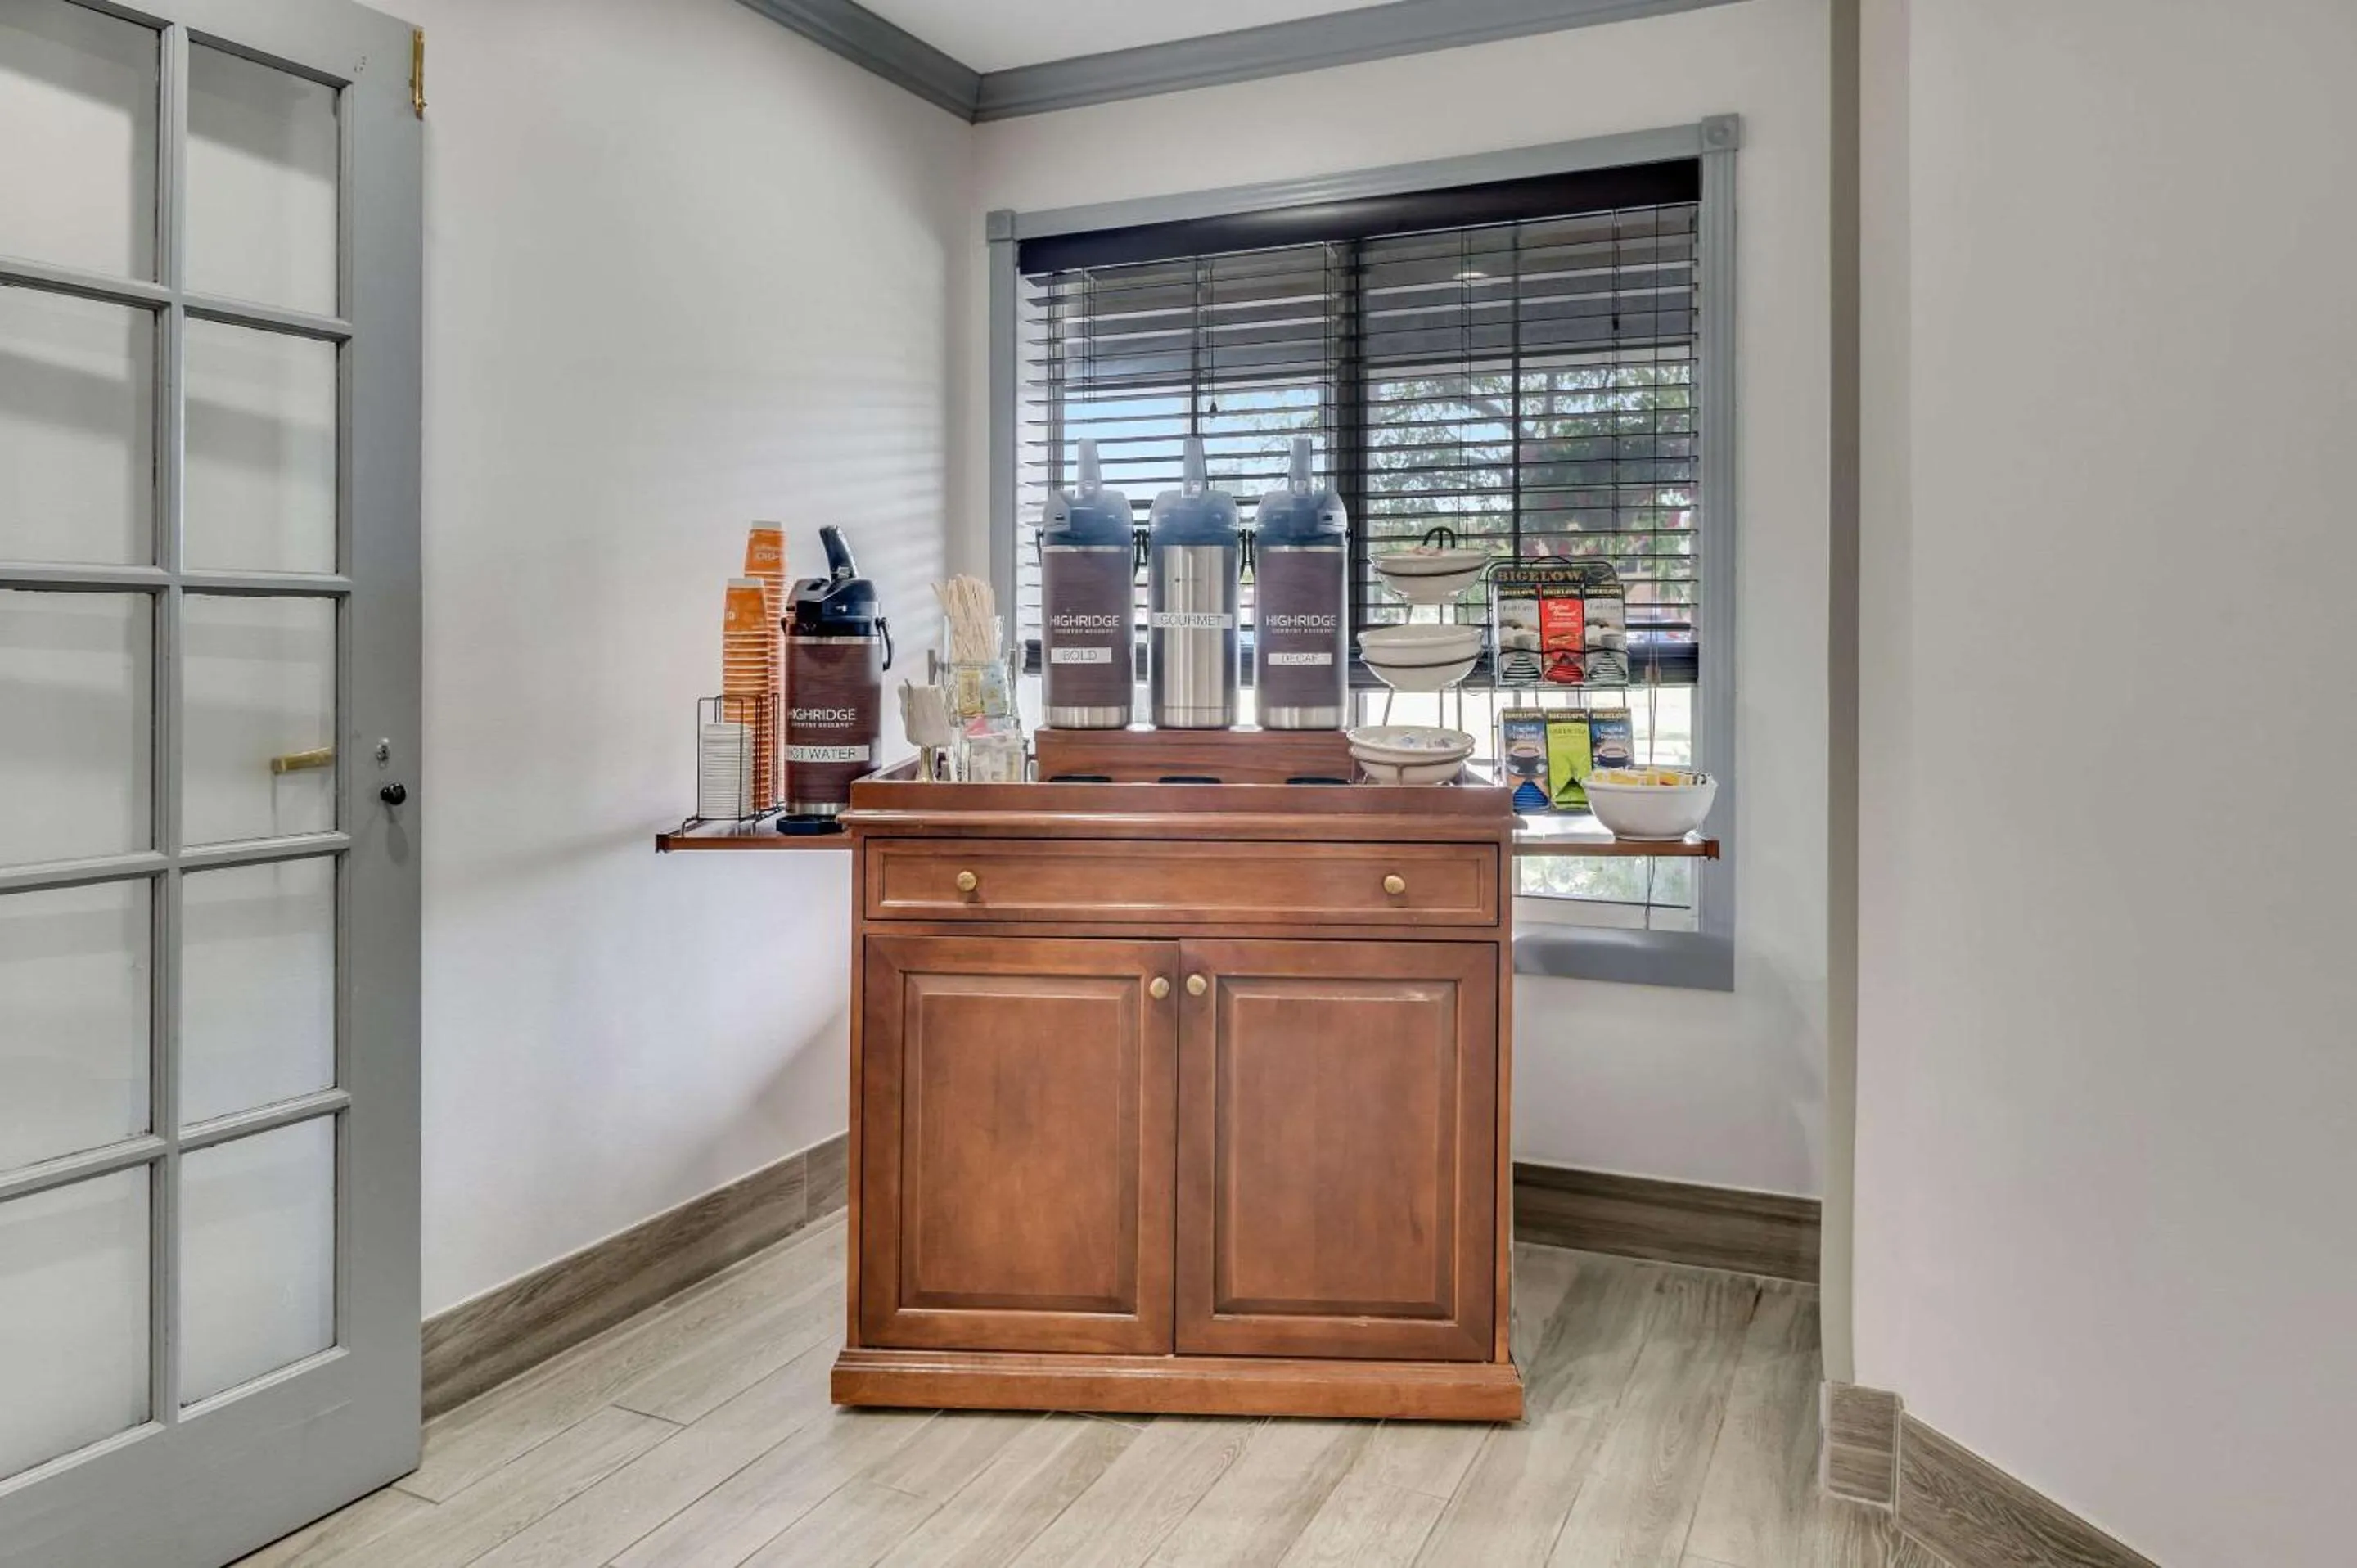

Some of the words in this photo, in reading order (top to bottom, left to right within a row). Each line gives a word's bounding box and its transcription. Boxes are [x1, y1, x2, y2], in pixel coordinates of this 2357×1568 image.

[1498, 570, 1580, 582] BIGELOW
[1049, 615, 1120, 627] HIGHRIDGE
[1160, 614, 1223, 626] GOURMET
[1265, 615, 1336, 627] HIGHRIDGE
[1063, 650, 1097, 661] BOLD
[809, 748, 856, 759] WATER
